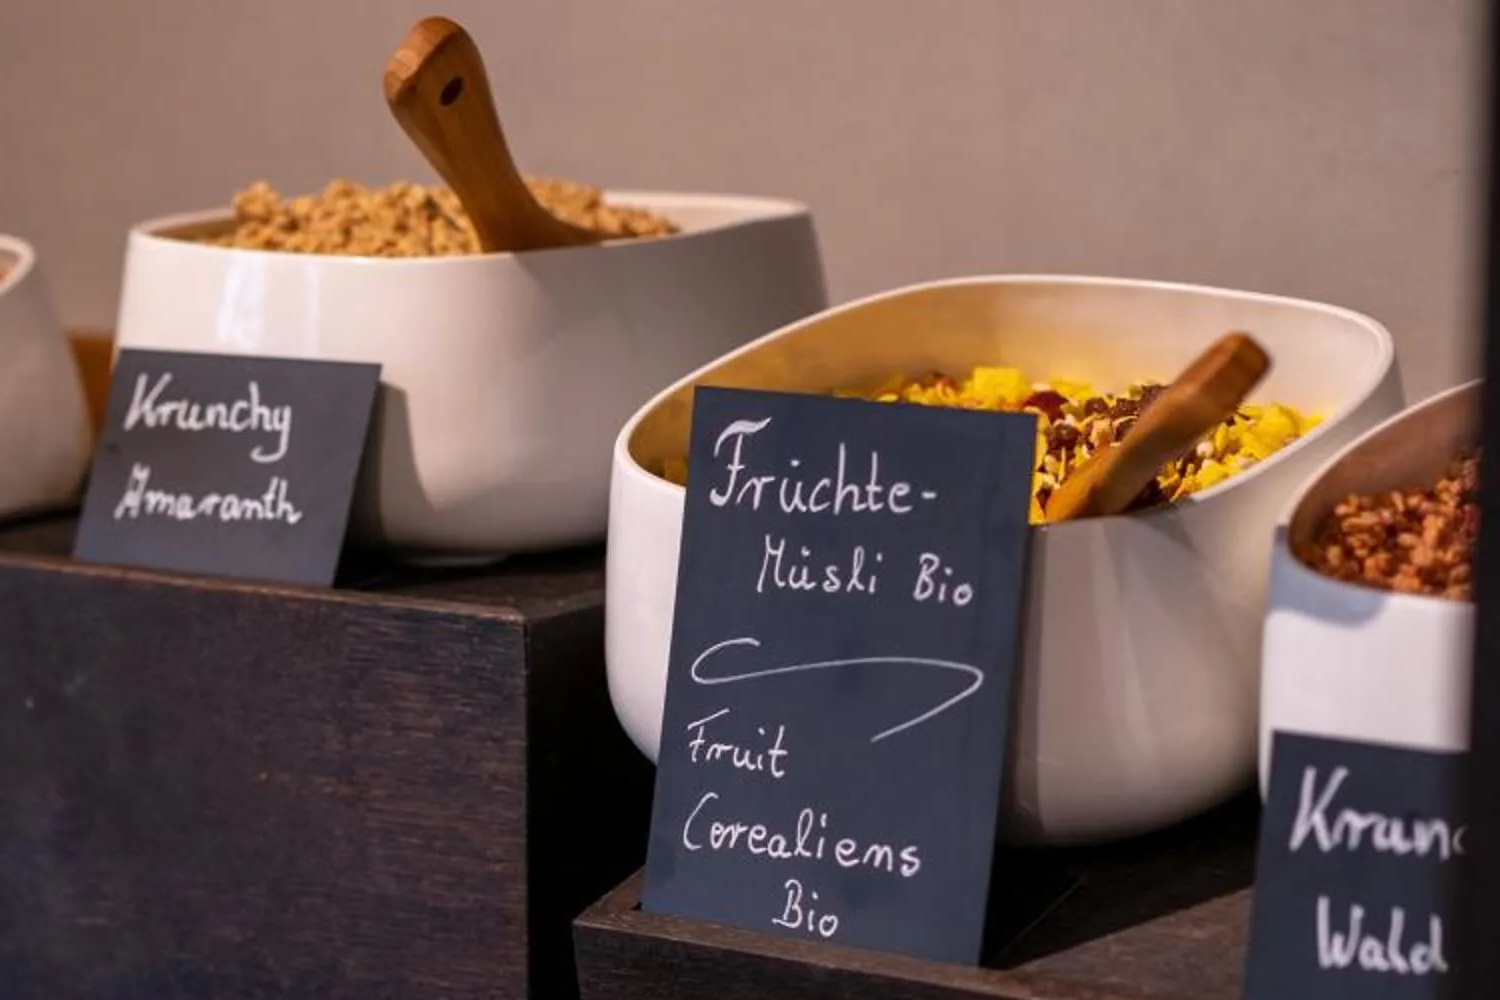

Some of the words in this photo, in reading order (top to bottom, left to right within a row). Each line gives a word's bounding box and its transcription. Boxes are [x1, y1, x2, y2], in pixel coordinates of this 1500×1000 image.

[123, 373, 292, 462] Krunchy
[113, 463, 303, 524] Amaranth
[709, 416, 938, 515] Früchte-
[756, 534, 884, 593] Müsli
[912, 553, 974, 606] Bio
[687, 708, 788, 778] Fruit
[771, 879, 839, 937] Bio
[1316, 895, 1449, 975] Wald
